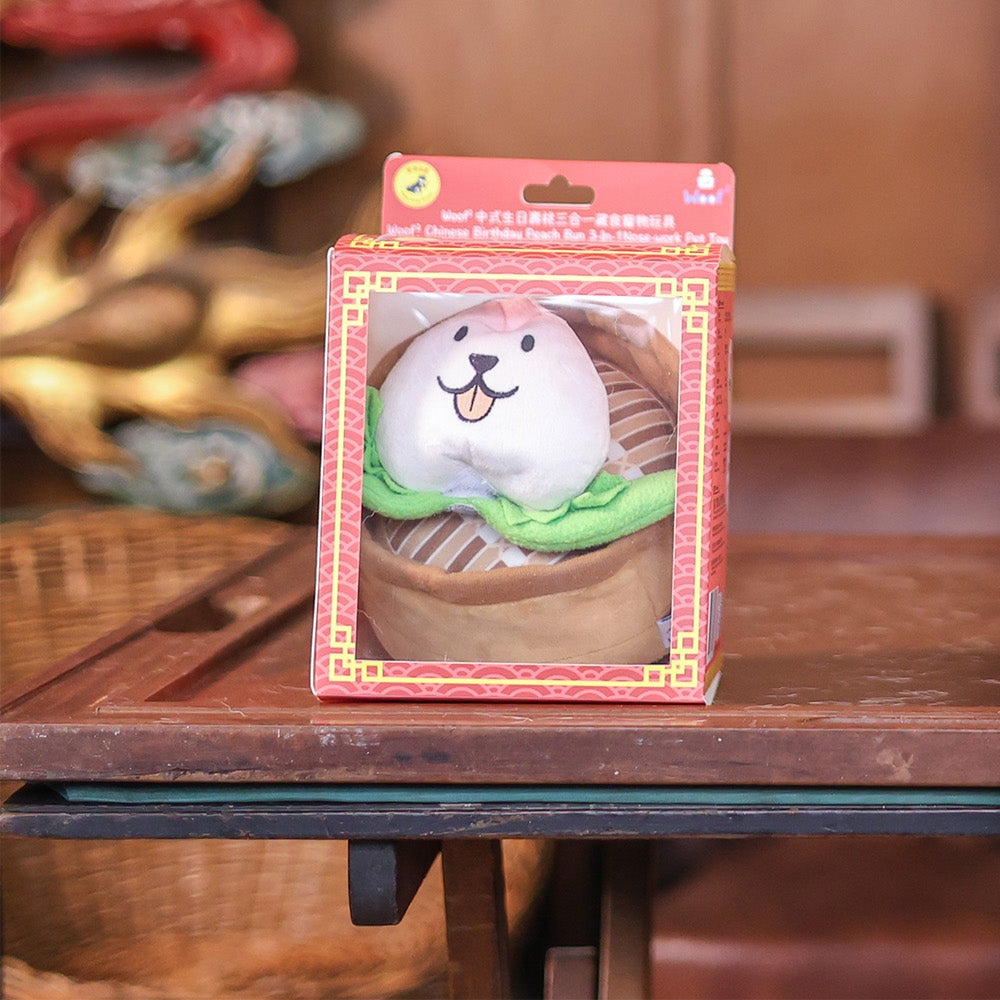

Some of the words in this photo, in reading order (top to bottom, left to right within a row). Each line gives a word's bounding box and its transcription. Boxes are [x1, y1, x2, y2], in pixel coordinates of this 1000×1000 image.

[424, 224, 470, 238] Chinese
[472, 225, 523, 240] Birthday
[563, 228, 586, 241] Bun
